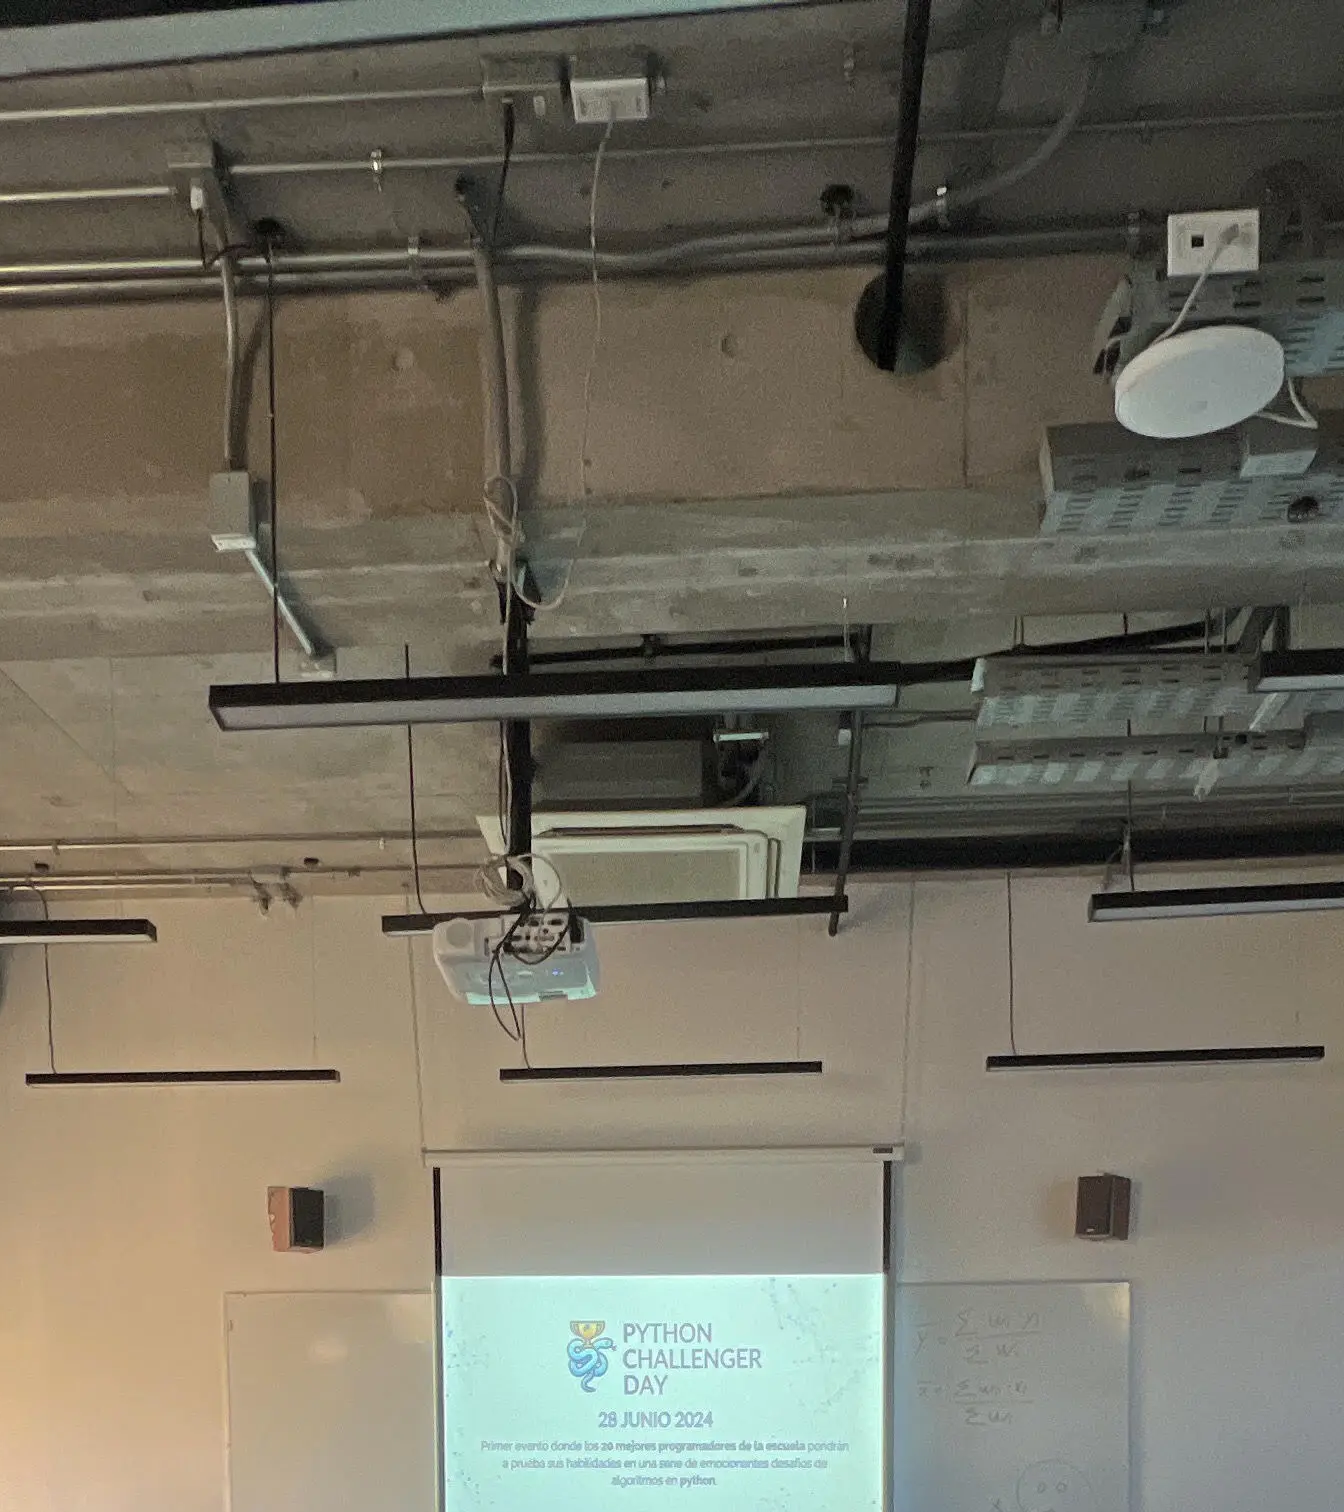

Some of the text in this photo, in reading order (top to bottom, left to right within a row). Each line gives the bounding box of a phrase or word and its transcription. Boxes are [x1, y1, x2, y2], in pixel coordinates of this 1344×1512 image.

[623, 1322, 713, 1344] PYTHON
[622, 1348, 763, 1369] CHALLENGER
[623, 1374, 669, 1396] DAY
[598, 1410, 714, 1429] 28 JUNIO 2024
